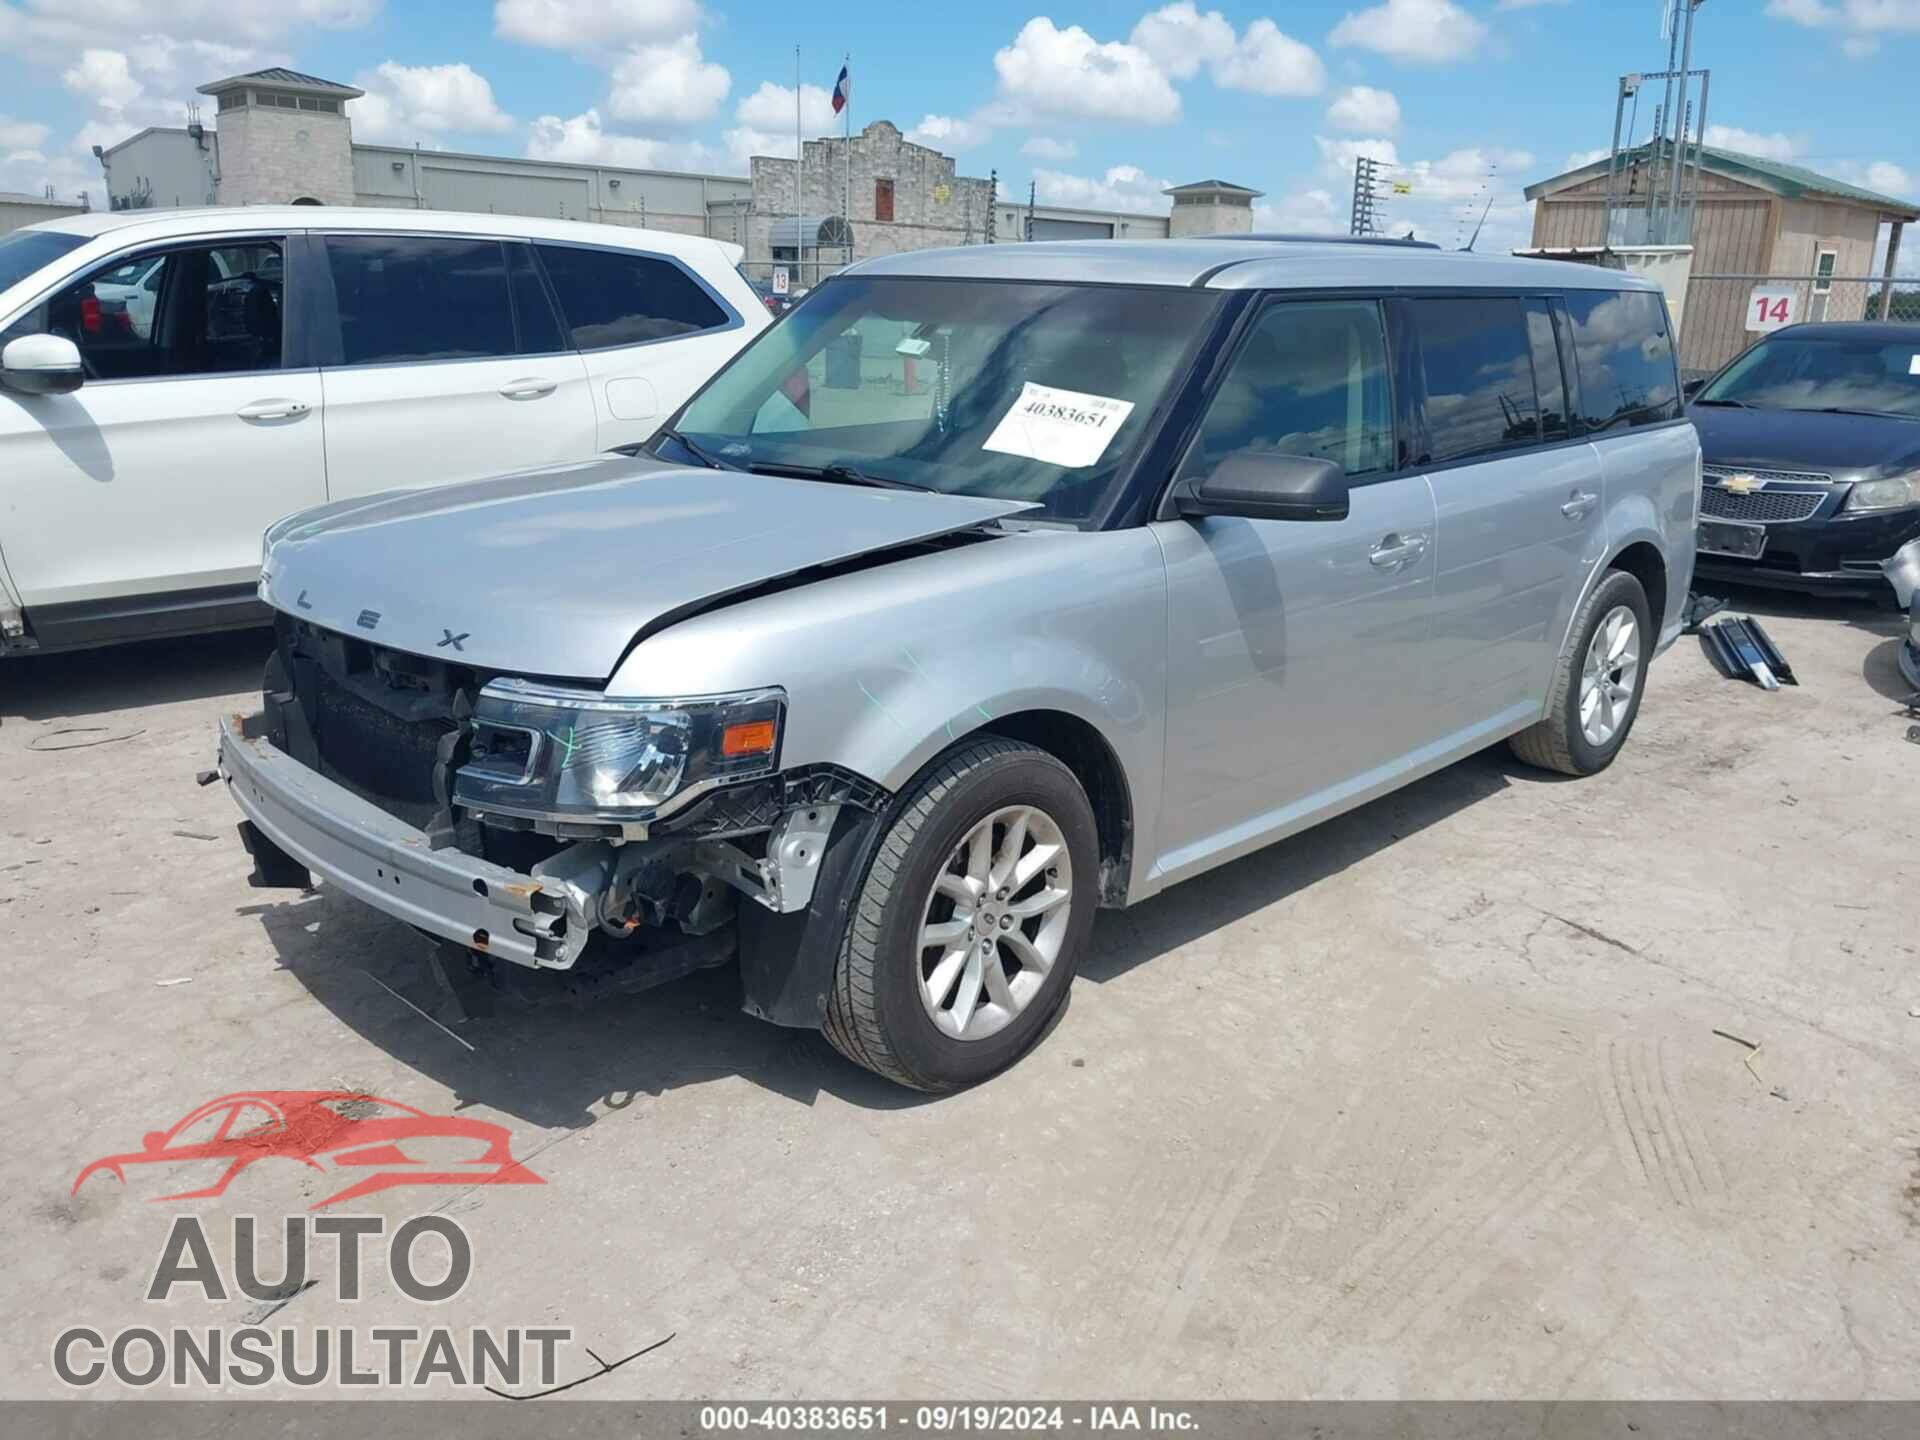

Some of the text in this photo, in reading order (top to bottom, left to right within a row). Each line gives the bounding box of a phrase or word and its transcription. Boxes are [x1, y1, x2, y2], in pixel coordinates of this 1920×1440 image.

[776, 273, 787, 289] 13
[1756, 296, 1790, 323] 14
[1023, 401, 1108, 428] 40383651
